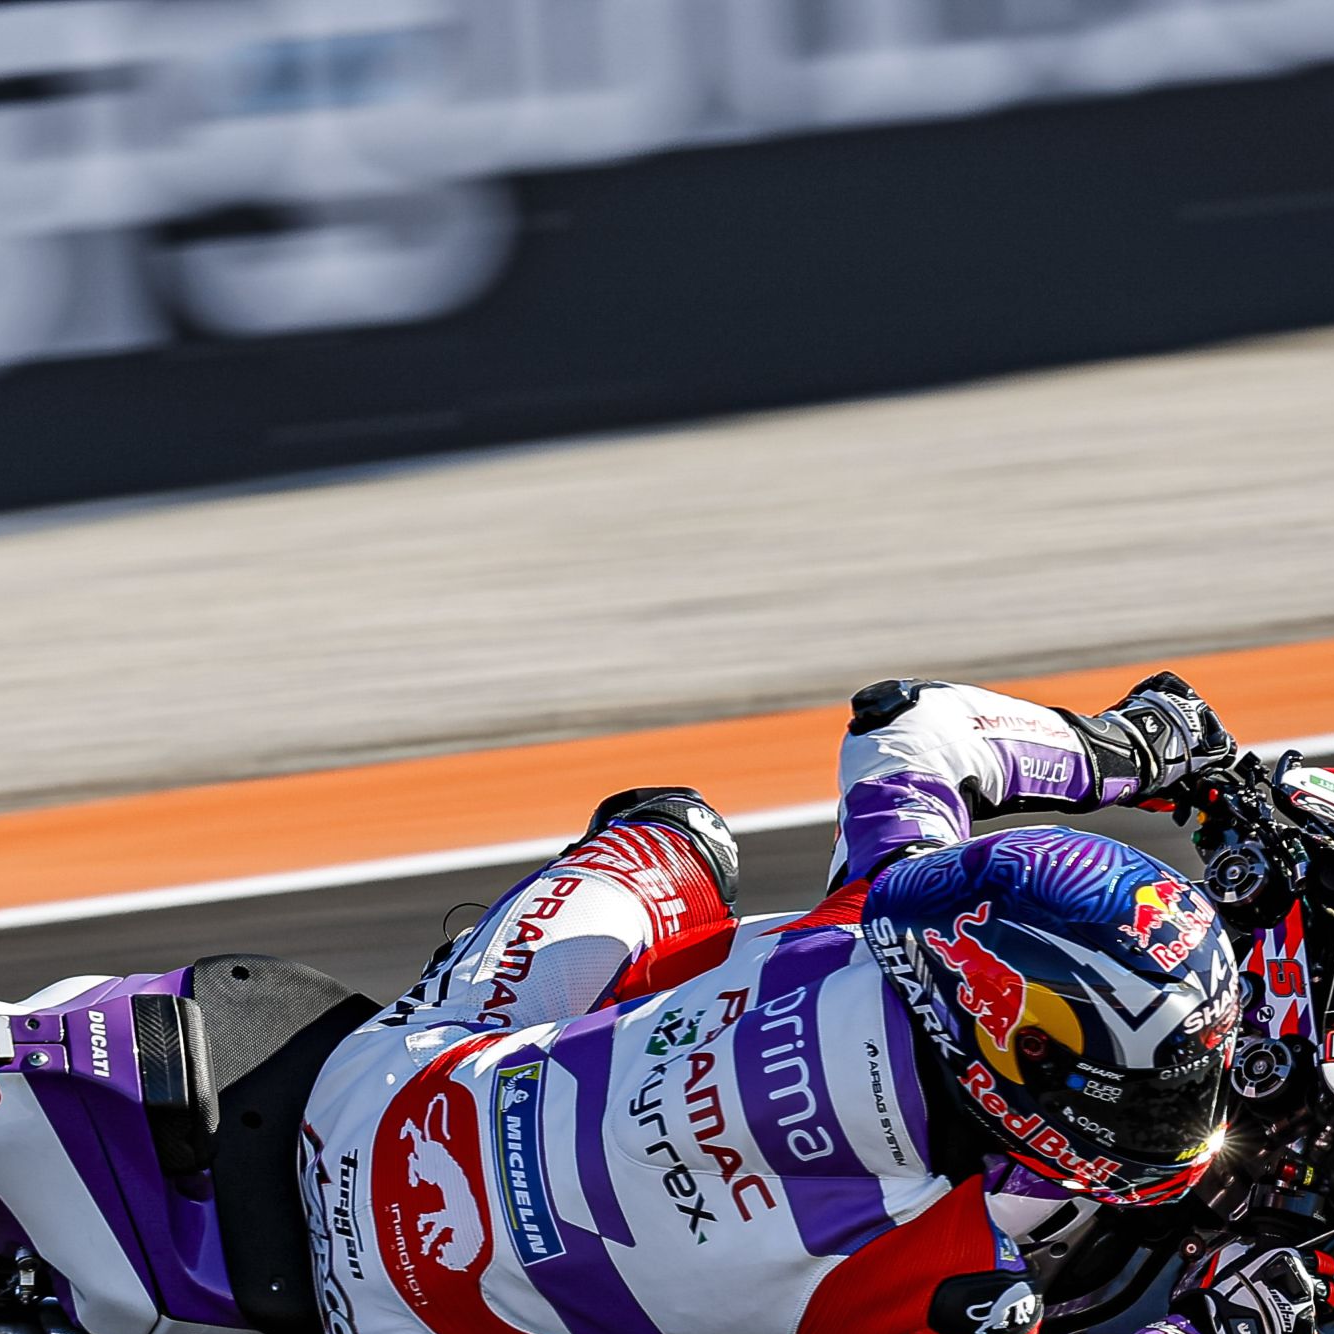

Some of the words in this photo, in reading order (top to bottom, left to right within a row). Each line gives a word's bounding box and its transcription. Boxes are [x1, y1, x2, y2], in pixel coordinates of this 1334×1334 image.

[1019, 754, 1068, 784] prima
[476, 876, 585, 1029] PRAMAC
[871, 915, 965, 1061] SHARK
[87, 1008, 111, 1079] DUCATI
[759, 984, 835, 1163] prima
[1075, 1061, 1127, 1081] SHARK
[866, 1060, 887, 1114] AIRBAG
[879, 1115, 908, 1168] SYSTEM
[958, 1060, 1039, 1141] Red
[1029, 1124, 1123, 1185] Bull
[504, 1114, 549, 1256] MICHELIN
